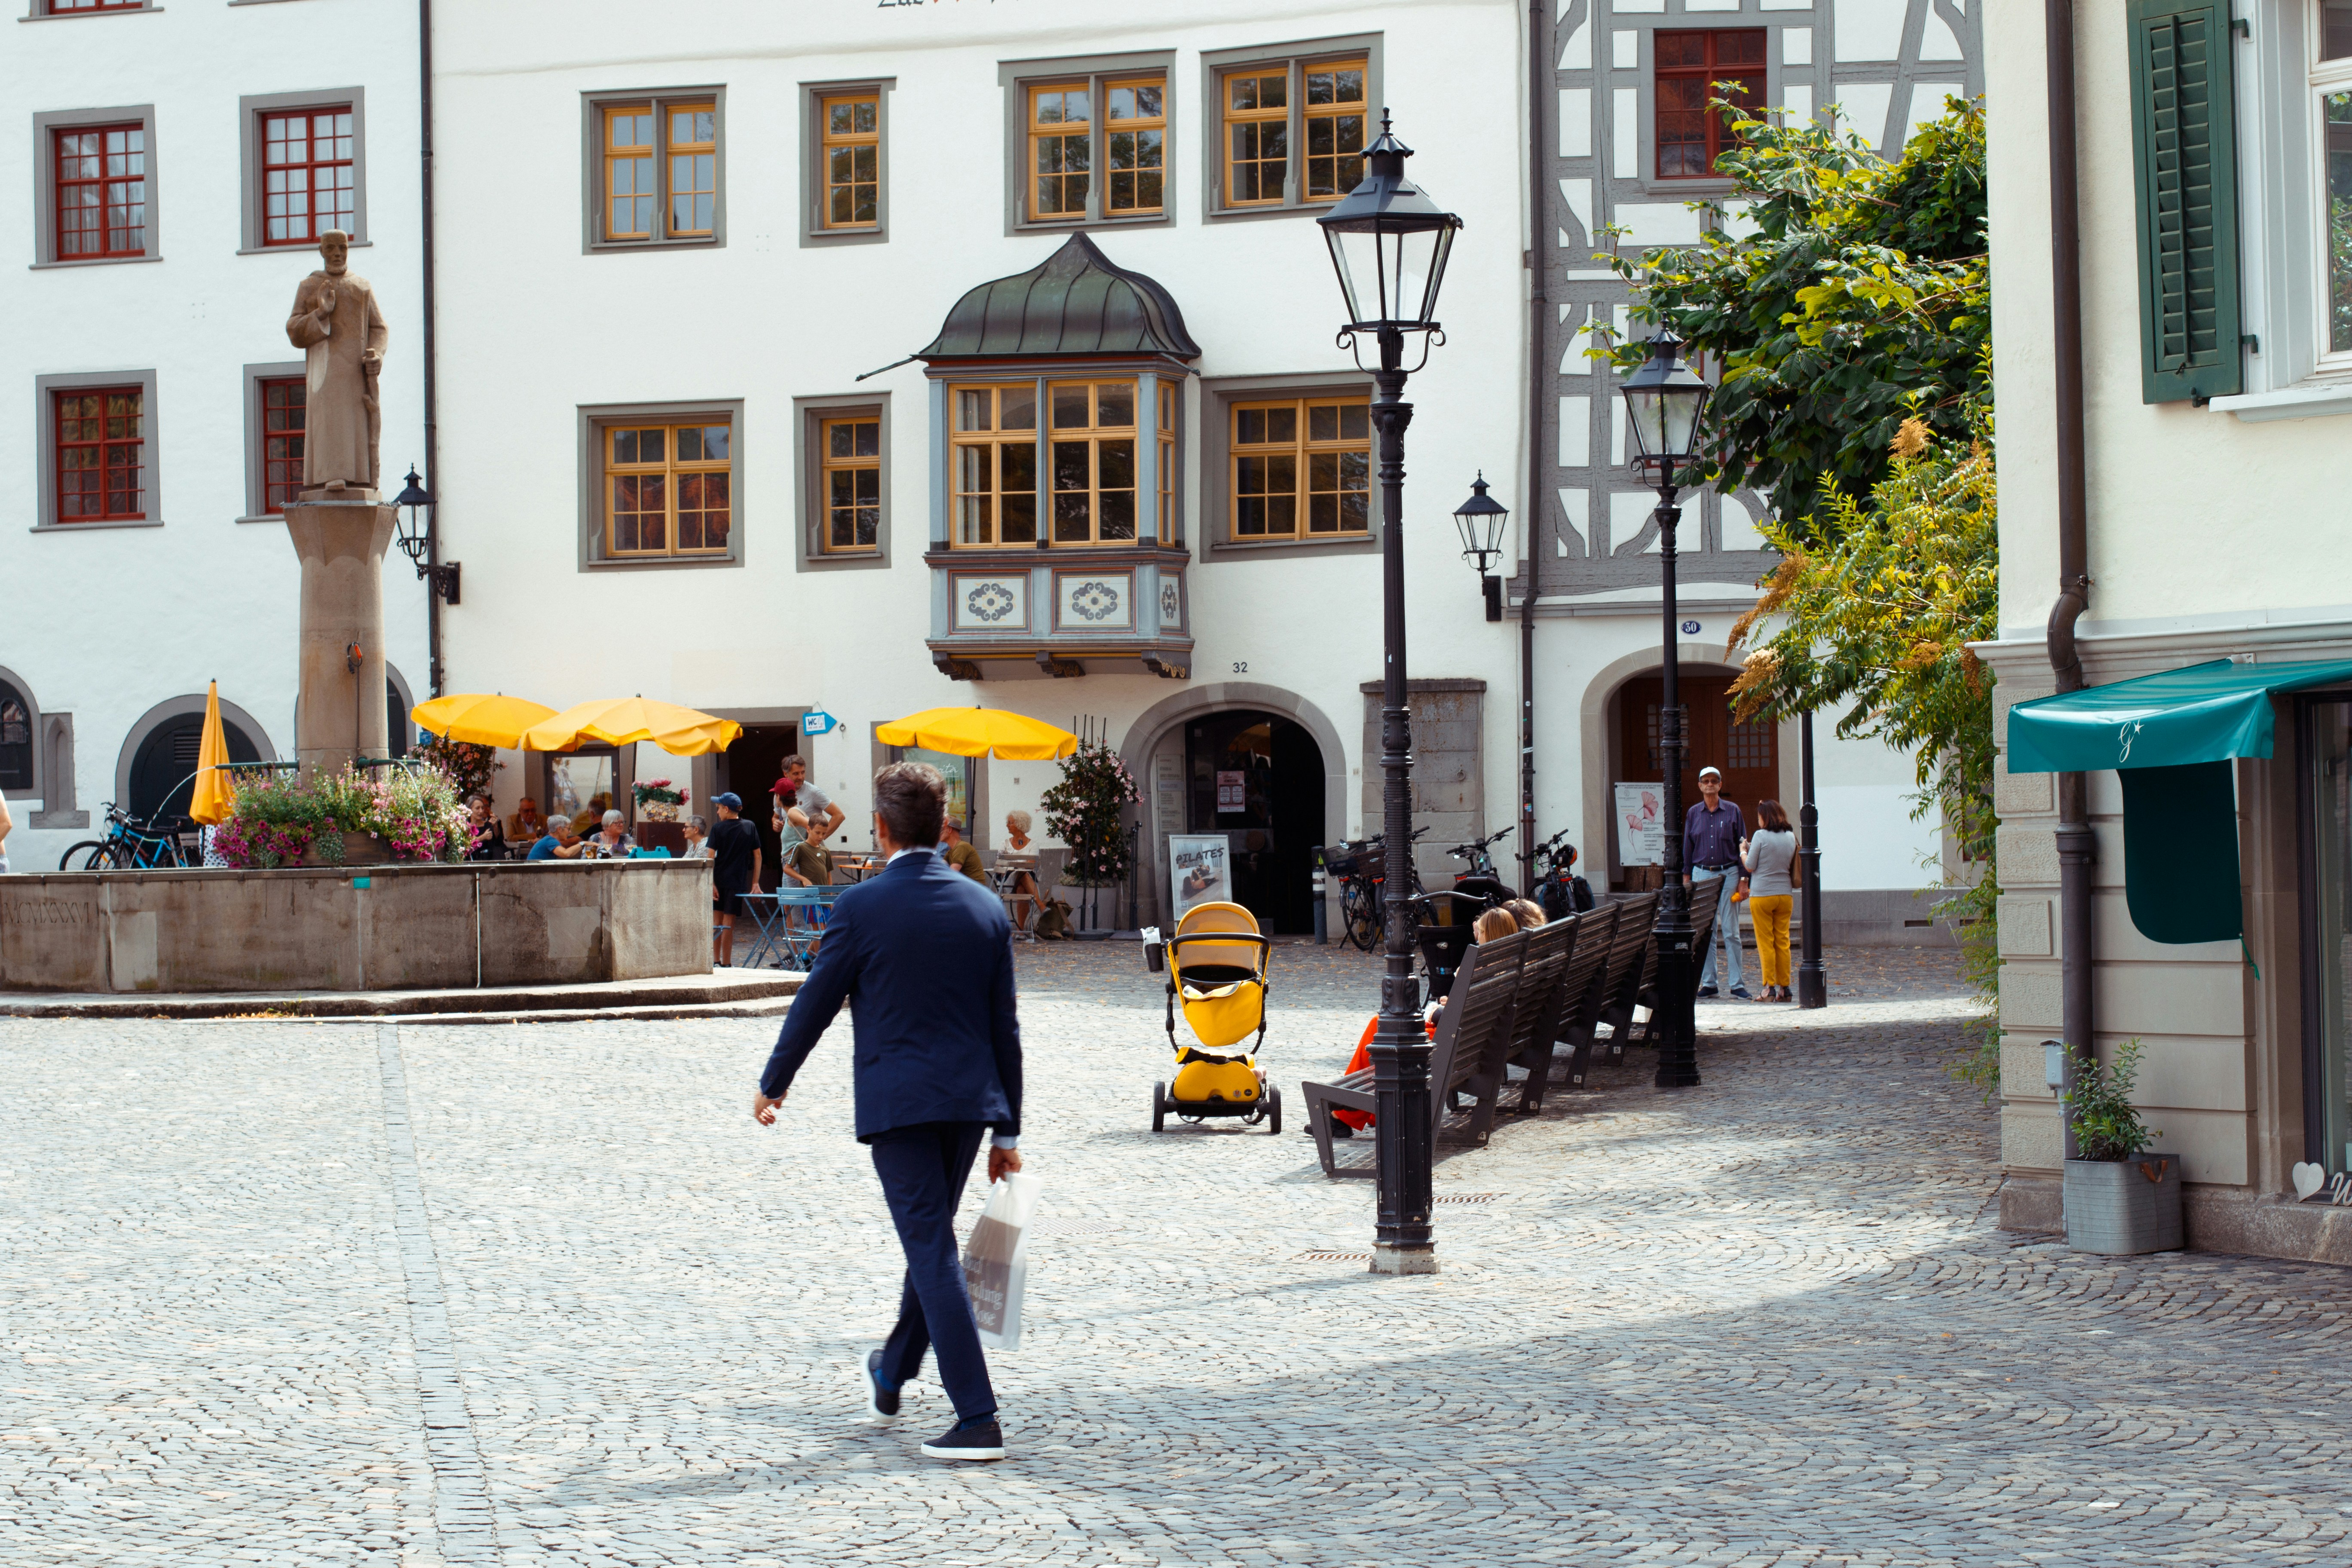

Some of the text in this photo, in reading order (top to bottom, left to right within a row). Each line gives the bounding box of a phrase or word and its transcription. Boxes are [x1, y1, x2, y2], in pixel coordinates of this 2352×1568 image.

[1685, 622, 1697, 632] 30
[1233, 662, 1247, 673] 32
[1176, 847, 1224, 864] PILATES
[4, 901, 91, 925] MCMXXXVI
